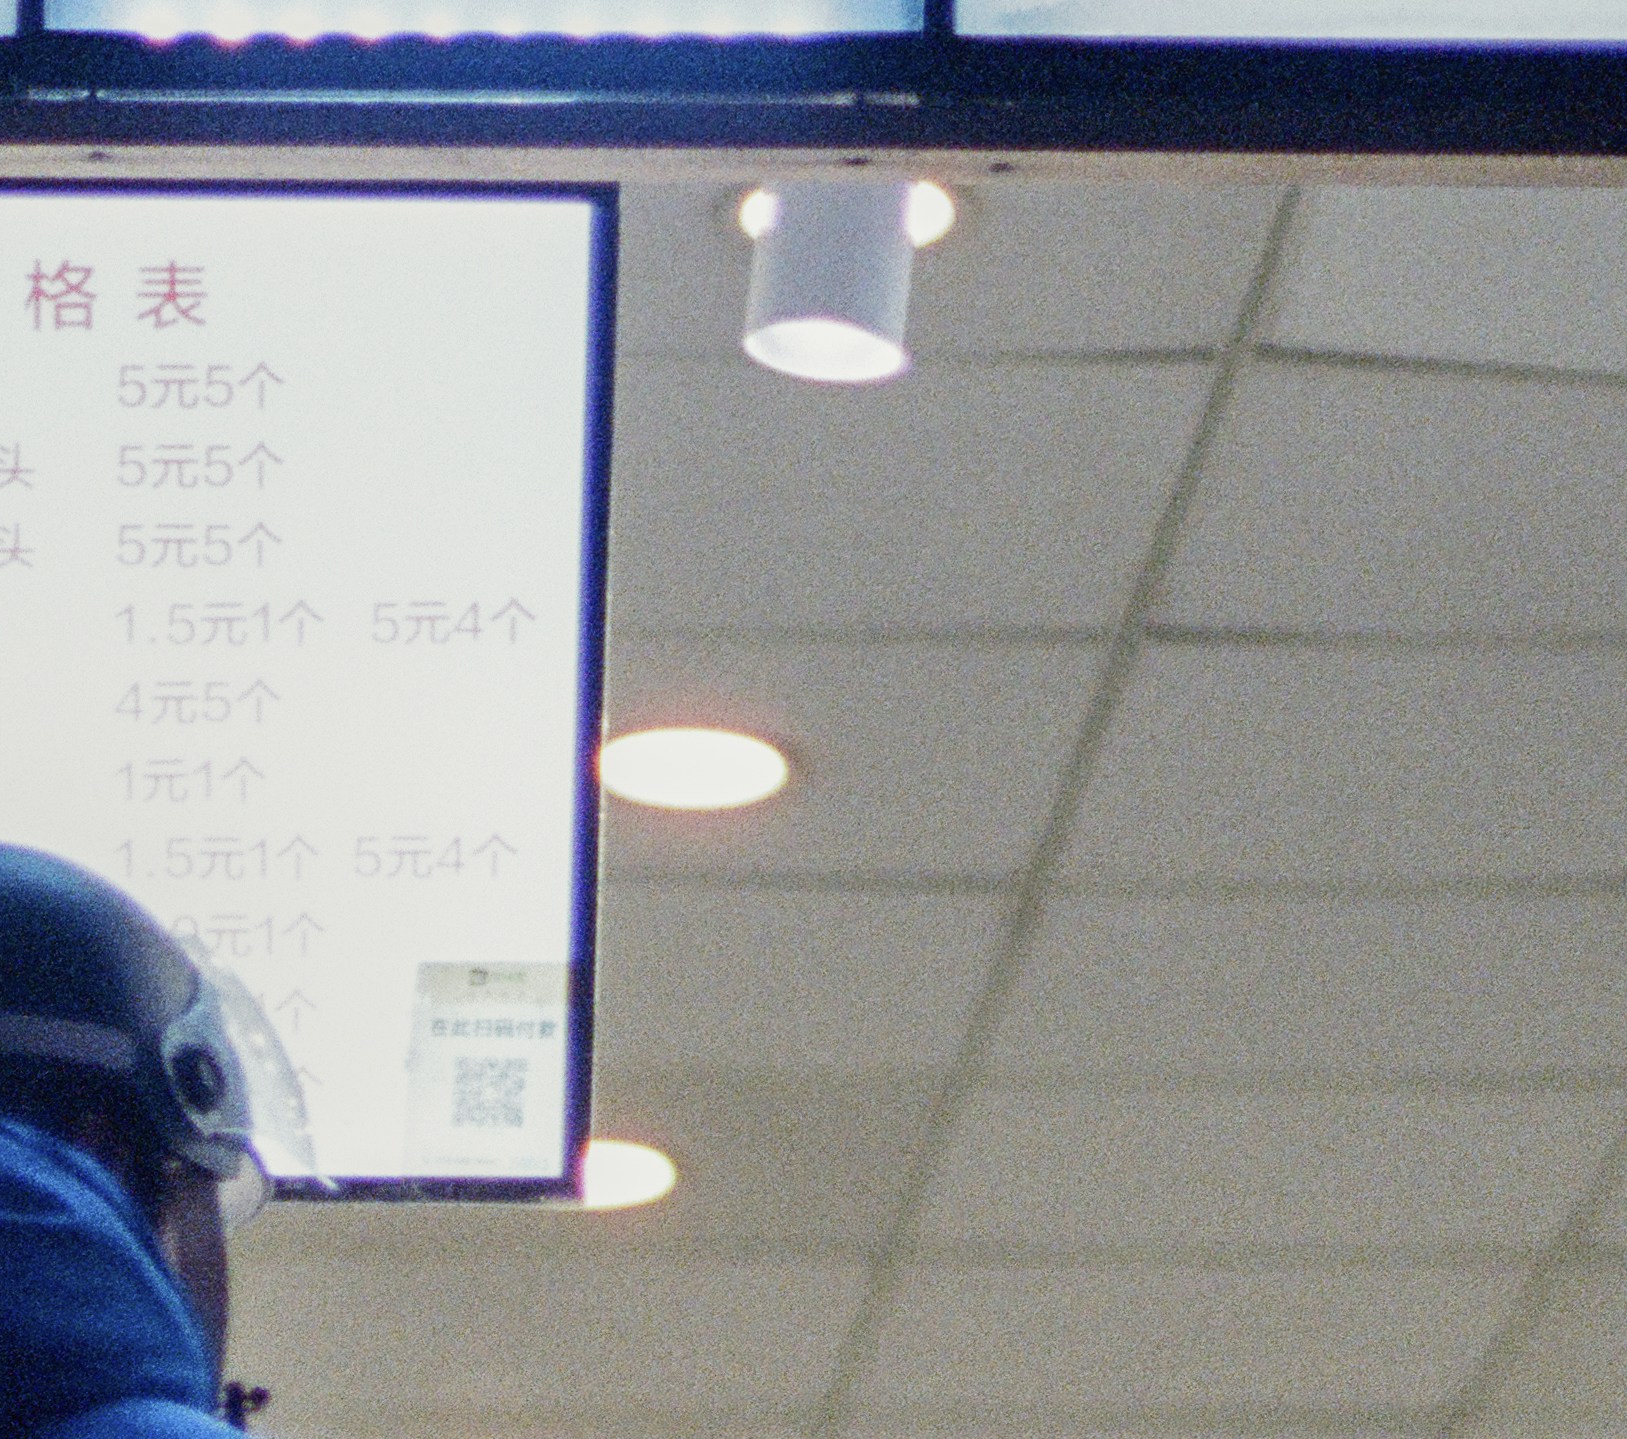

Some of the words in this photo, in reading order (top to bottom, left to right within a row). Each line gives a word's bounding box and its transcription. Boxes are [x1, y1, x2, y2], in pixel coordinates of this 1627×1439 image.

[118, 360, 285, 410] 5元5个
[117, 440, 284, 489] 5元5个
[116, 520, 283, 569] 5元5个
[115, 598, 324, 647] 1.5元1个
[372, 597, 537, 645] 5元4个
[113, 676, 281, 726] 4元5个
[116, 755, 266, 804] 1元1个
[117, 836, 319, 883] 1.5元1个
[354, 832, 519, 880] 5元4个
